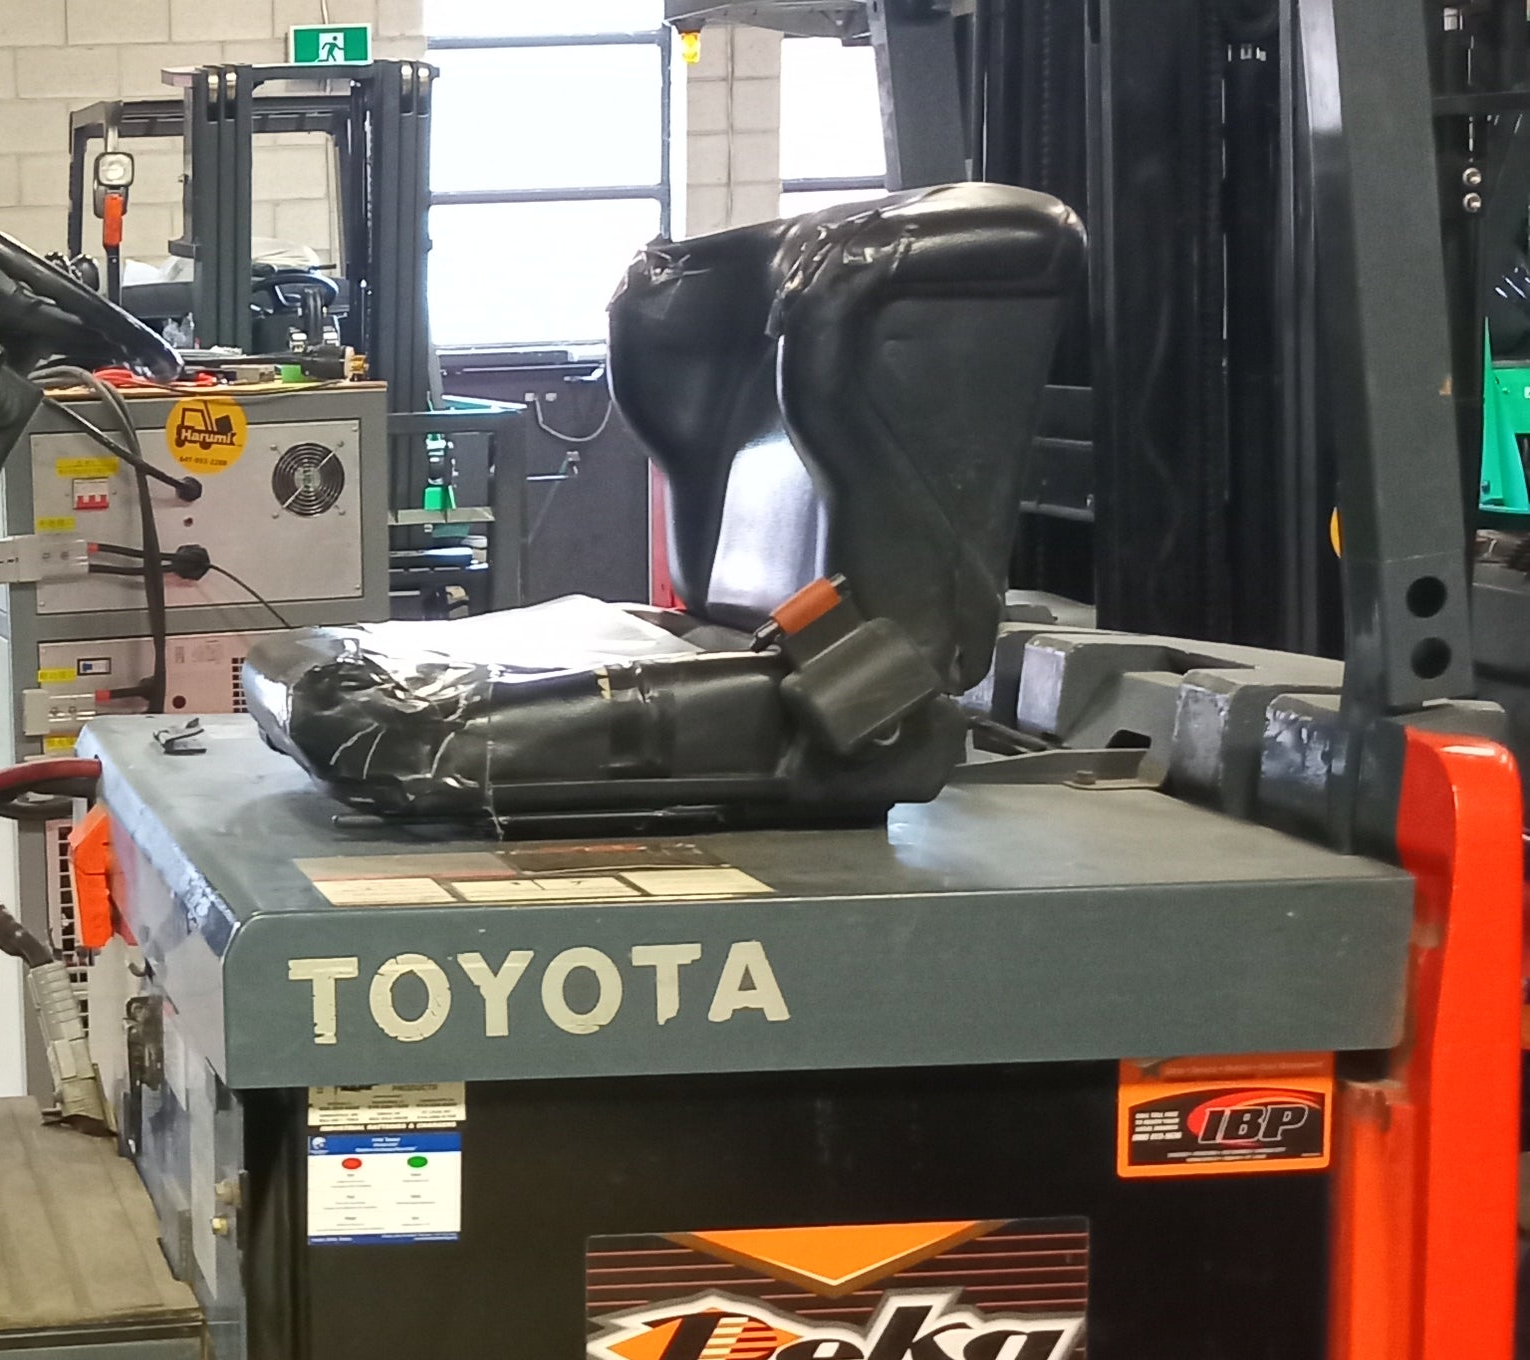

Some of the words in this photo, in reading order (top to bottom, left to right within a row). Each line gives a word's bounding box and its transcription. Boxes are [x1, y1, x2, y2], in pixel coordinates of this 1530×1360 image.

[181, 429, 232, 444] Harumi
[288, 940, 791, 1044] TOYOTA
[1197, 1104, 1309, 1144] IBP
